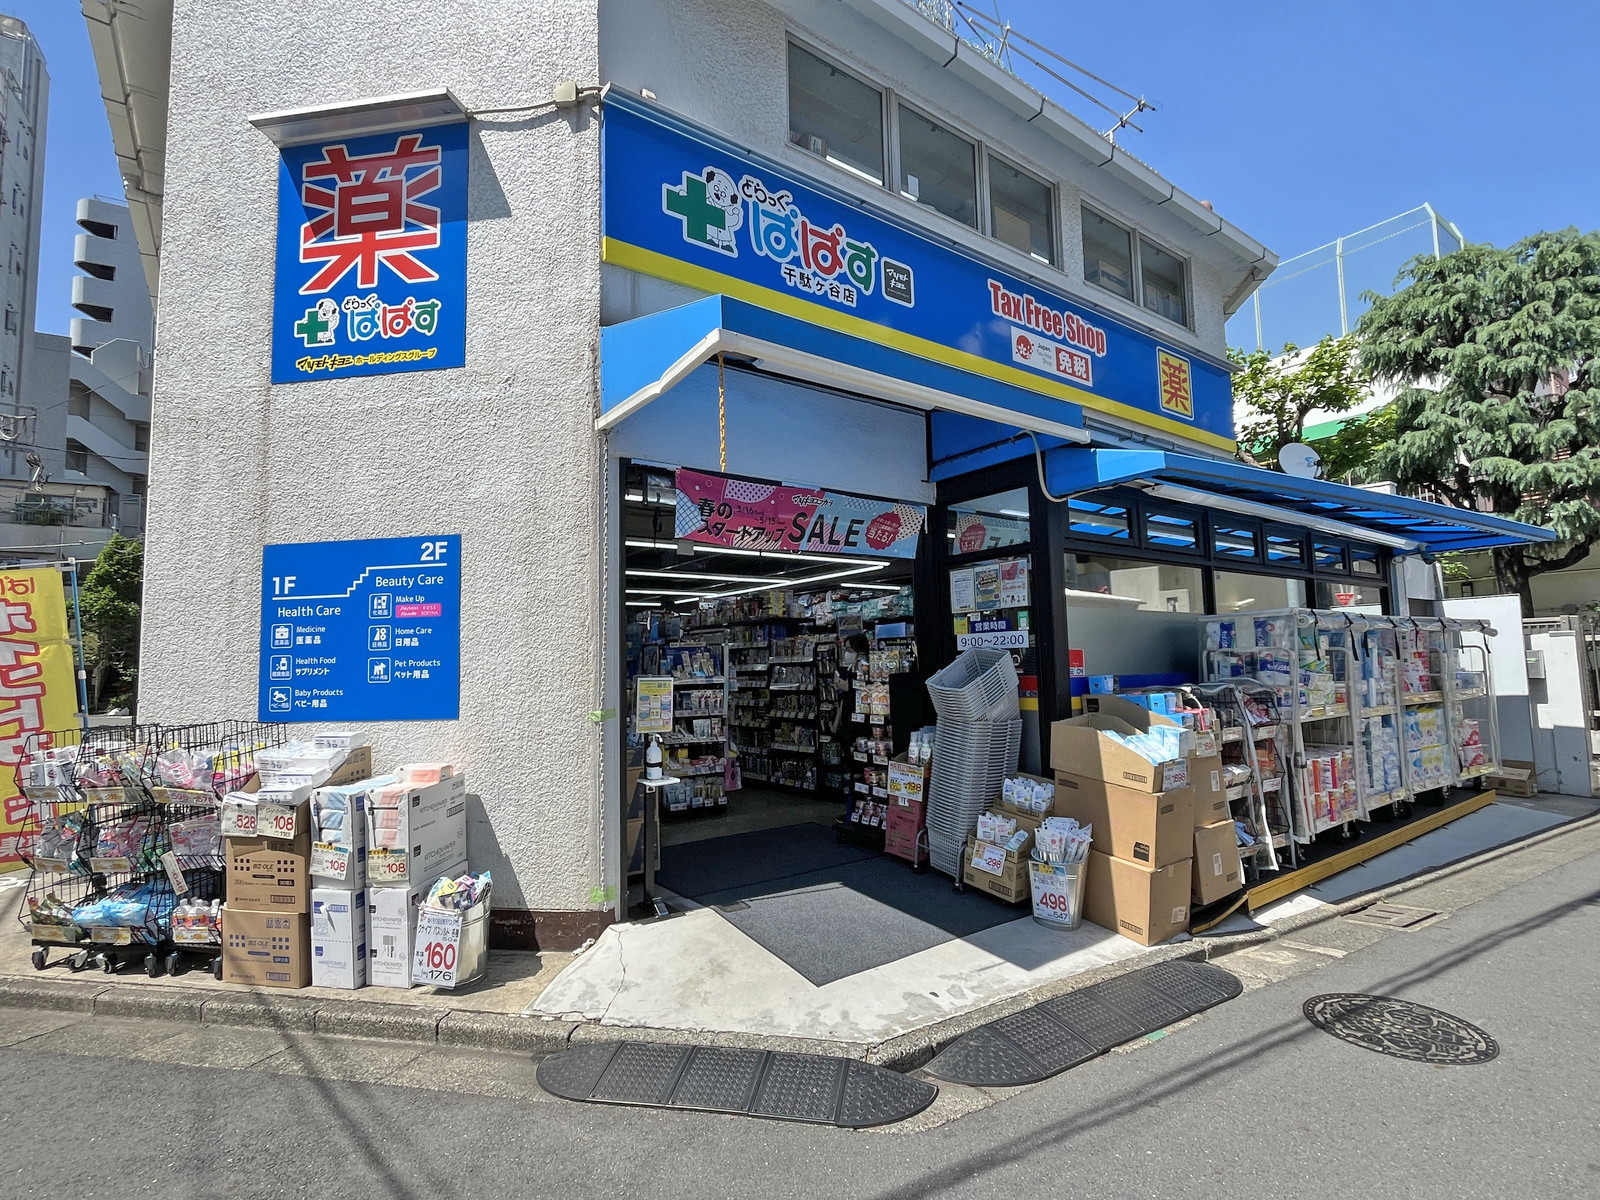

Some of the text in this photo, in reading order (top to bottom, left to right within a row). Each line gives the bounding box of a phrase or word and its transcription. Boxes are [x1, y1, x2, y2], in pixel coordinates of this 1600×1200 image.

[742, 178, 789, 212] どらっぐ
[299, 133, 441, 295] 薬
[753, 200, 877, 292] ぱぱす
[343, 294, 377, 310] どらっぐ
[350, 299, 441, 341] ぱぱす
[989, 281, 1106, 355] Tax Free Shop
[1059, 350, 1087, 379] 免税
[1161, 356, 1190, 413] 薬
[698, 498, 733, 519] 春の
[697, 519, 787, 543] スタートアップ
[788, 511, 866, 548] SALE
[420, 541, 448, 561] 2F
[272, 576, 296, 594] 1F
[375, 574, 444, 588] Beauty Care
[415, 595, 425, 603] Up
[277, 605, 341, 618] Health Care
[974, 620, 1007, 632] 営業時間
[296, 635, 321, 645] 医薬品
[395, 637, 419, 647] 日用品
[295, 657, 318, 665] Health
[409, 659, 441, 667] Products
[295, 668, 330, 676] サプリメント
[394, 669, 430, 679] ペット用品
[294, 688, 344, 698] Baby Products
[294, 698, 328, 708] ベビー用品
[236, 815, 256, 829] 528
[274, 815, 294, 831] 108
[329, 860, 346, 872] 108
[386, 863, 406, 873] 108
[987, 857, 1001, 869] 298
[1040, 892, 1067, 912] 498
[1053, 912, 1068, 920] 547
[425, 941, 456, 970] 160
[428, 970, 452, 980] 176
